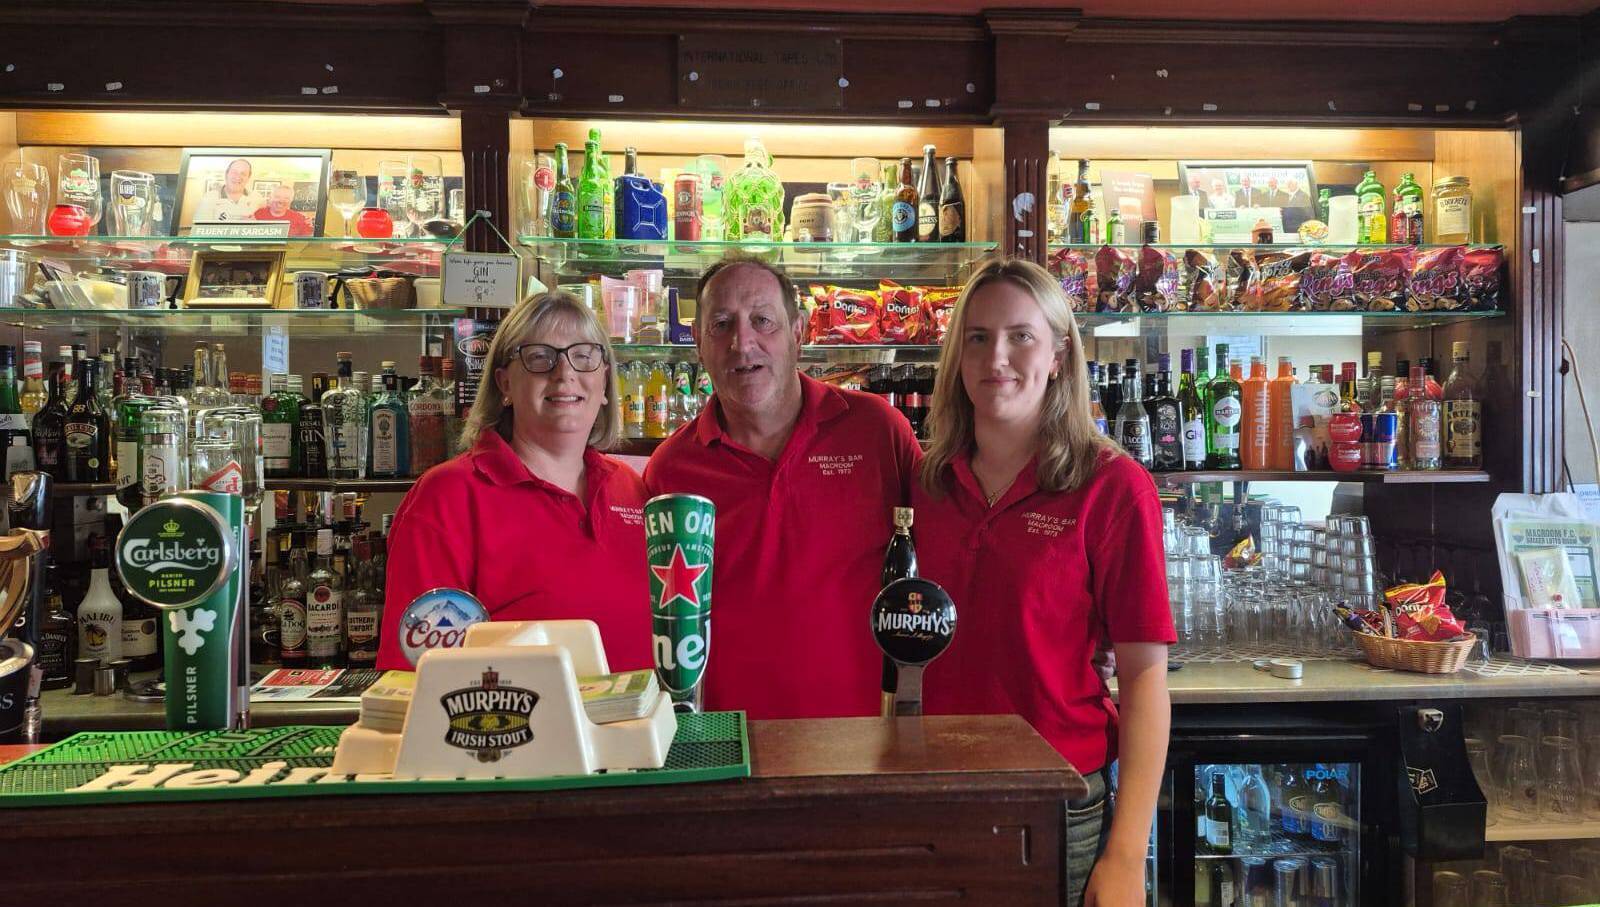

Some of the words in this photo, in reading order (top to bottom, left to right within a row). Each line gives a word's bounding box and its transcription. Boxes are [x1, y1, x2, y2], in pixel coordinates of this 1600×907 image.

[196, 227, 227, 236] FLUENT
[229, 227, 239, 236] IN
[241, 227, 282, 236] SARCASM
[473, 266, 489, 277] GIN
[300, 428, 325, 442] GIN
[808, 455, 846, 463] MURRAY'S
[848, 454, 863, 462] BAR
[1021, 511, 1059, 524] MURRAY'S
[1061, 518, 1077, 526] BAR
[123, 537, 220, 568] Carlsberg
[148, 579, 196, 588] PILSNER
[185, 666, 198, 724] PILSNER
[446, 690, 534, 717] MURPHY'S
[451, 731, 487, 747] IRISH
[488, 729, 528, 748] STOUT
[1305, 768, 1349, 780] POLAR
